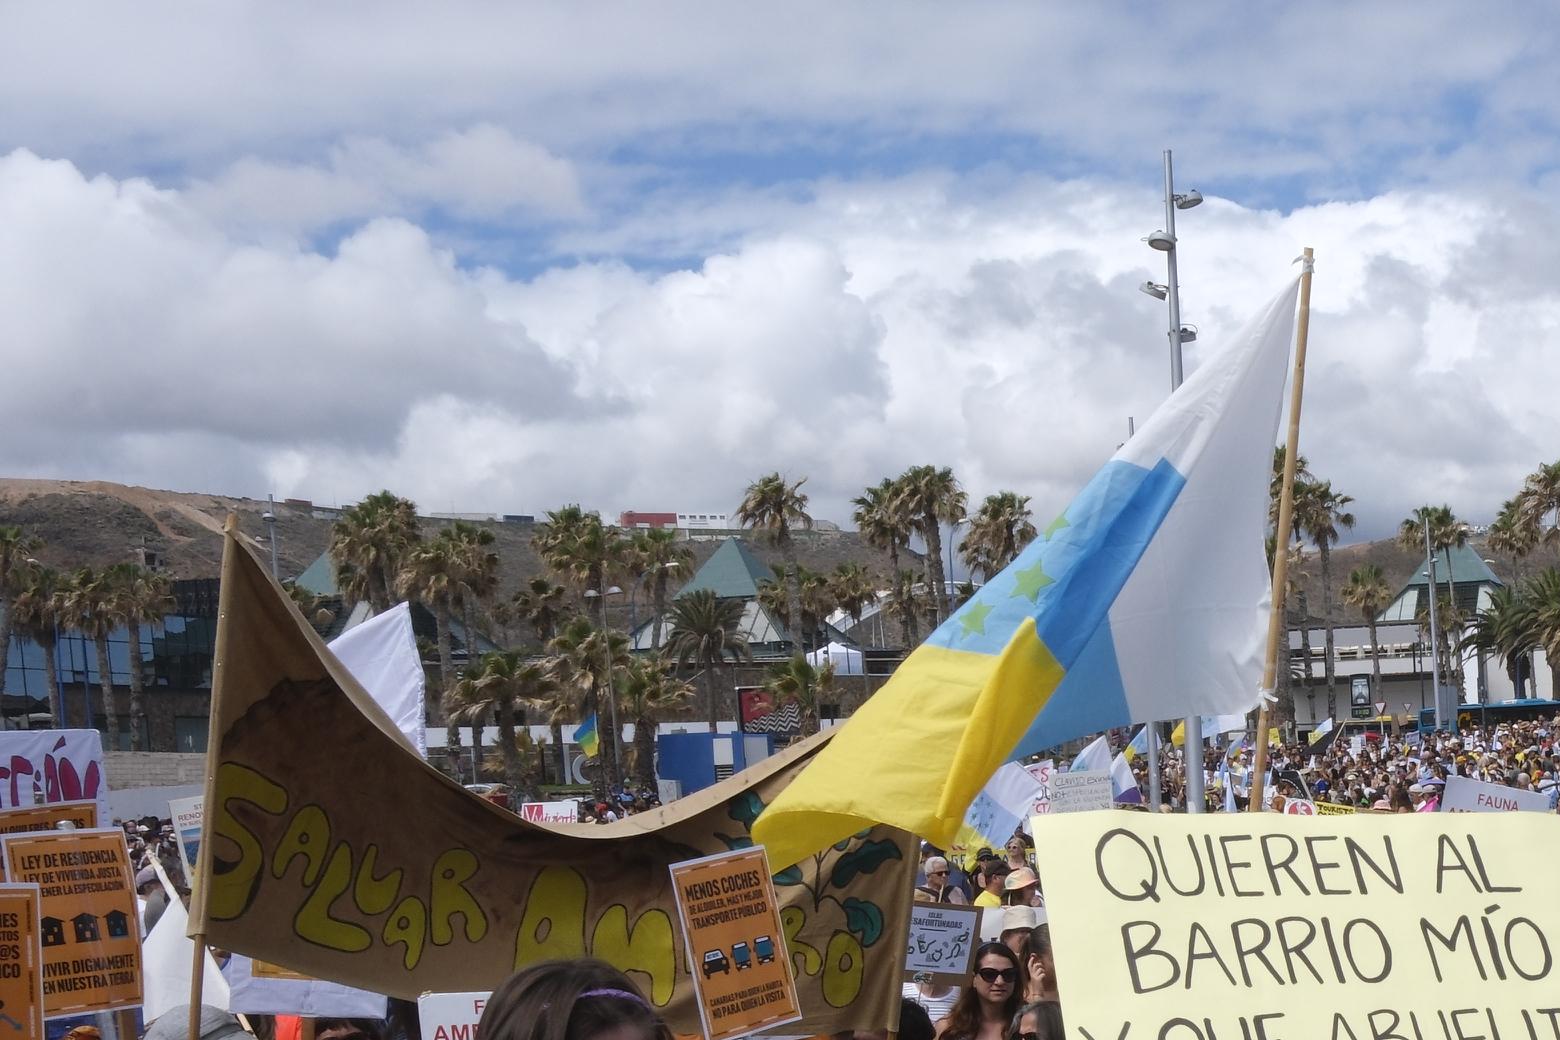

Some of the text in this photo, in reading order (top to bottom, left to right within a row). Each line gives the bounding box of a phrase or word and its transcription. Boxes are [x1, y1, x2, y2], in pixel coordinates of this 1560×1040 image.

[1477, 793, 1519, 812] FAUNA
[21, 849, 118, 870] LEY DE RESIDENCIA
[1095, 828, 1522, 902] QUIEREN AL
[42, 872, 56, 884] DE
[57, 868, 95, 882] VIVIENDA
[97, 867, 122, 879] JUSTA
[684, 870, 760, 902] MENOS COCHES
[691, 909, 739, 931] TRANSPORTE
[1121, 904, 1553, 993] BARRIO MÍO
[42, 954, 135, 978] VIVIR DIGNAMENTE
[43, 970, 135, 995] EN NUESTRA TIERRA
[710, 993, 736, 1007] CANARIAS
[722, 1004, 741, 1017] PARA
[765, 990, 786, 1004] VISITA
